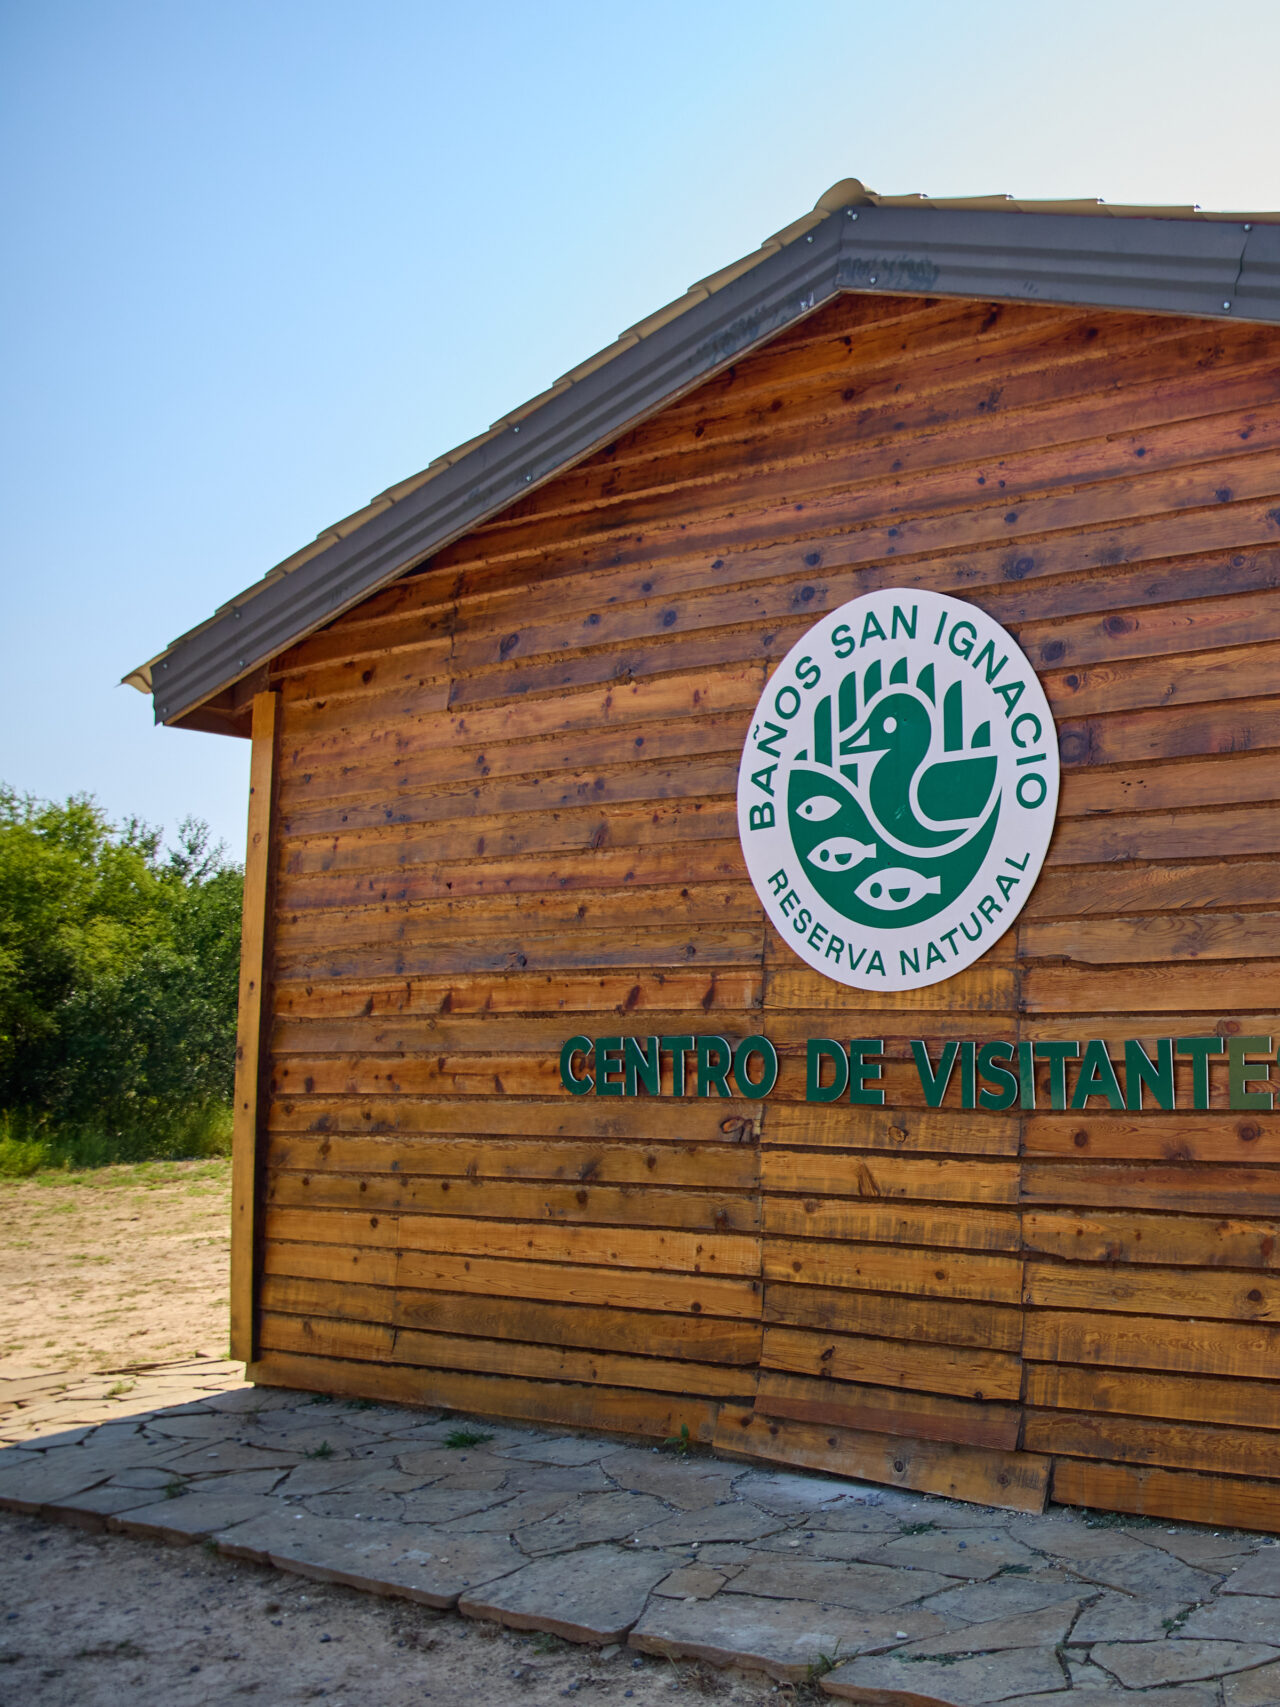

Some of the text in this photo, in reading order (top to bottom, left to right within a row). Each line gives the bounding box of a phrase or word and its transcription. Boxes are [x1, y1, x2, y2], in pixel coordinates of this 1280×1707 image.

[750, 605, 1048, 831] BAÑOS SAN IGNACIO
[767, 852, 1030, 976] RESERVA NATURAL
[560, 1035, 778, 1100] CENTRO
[806, 1040, 885, 1106] DE
